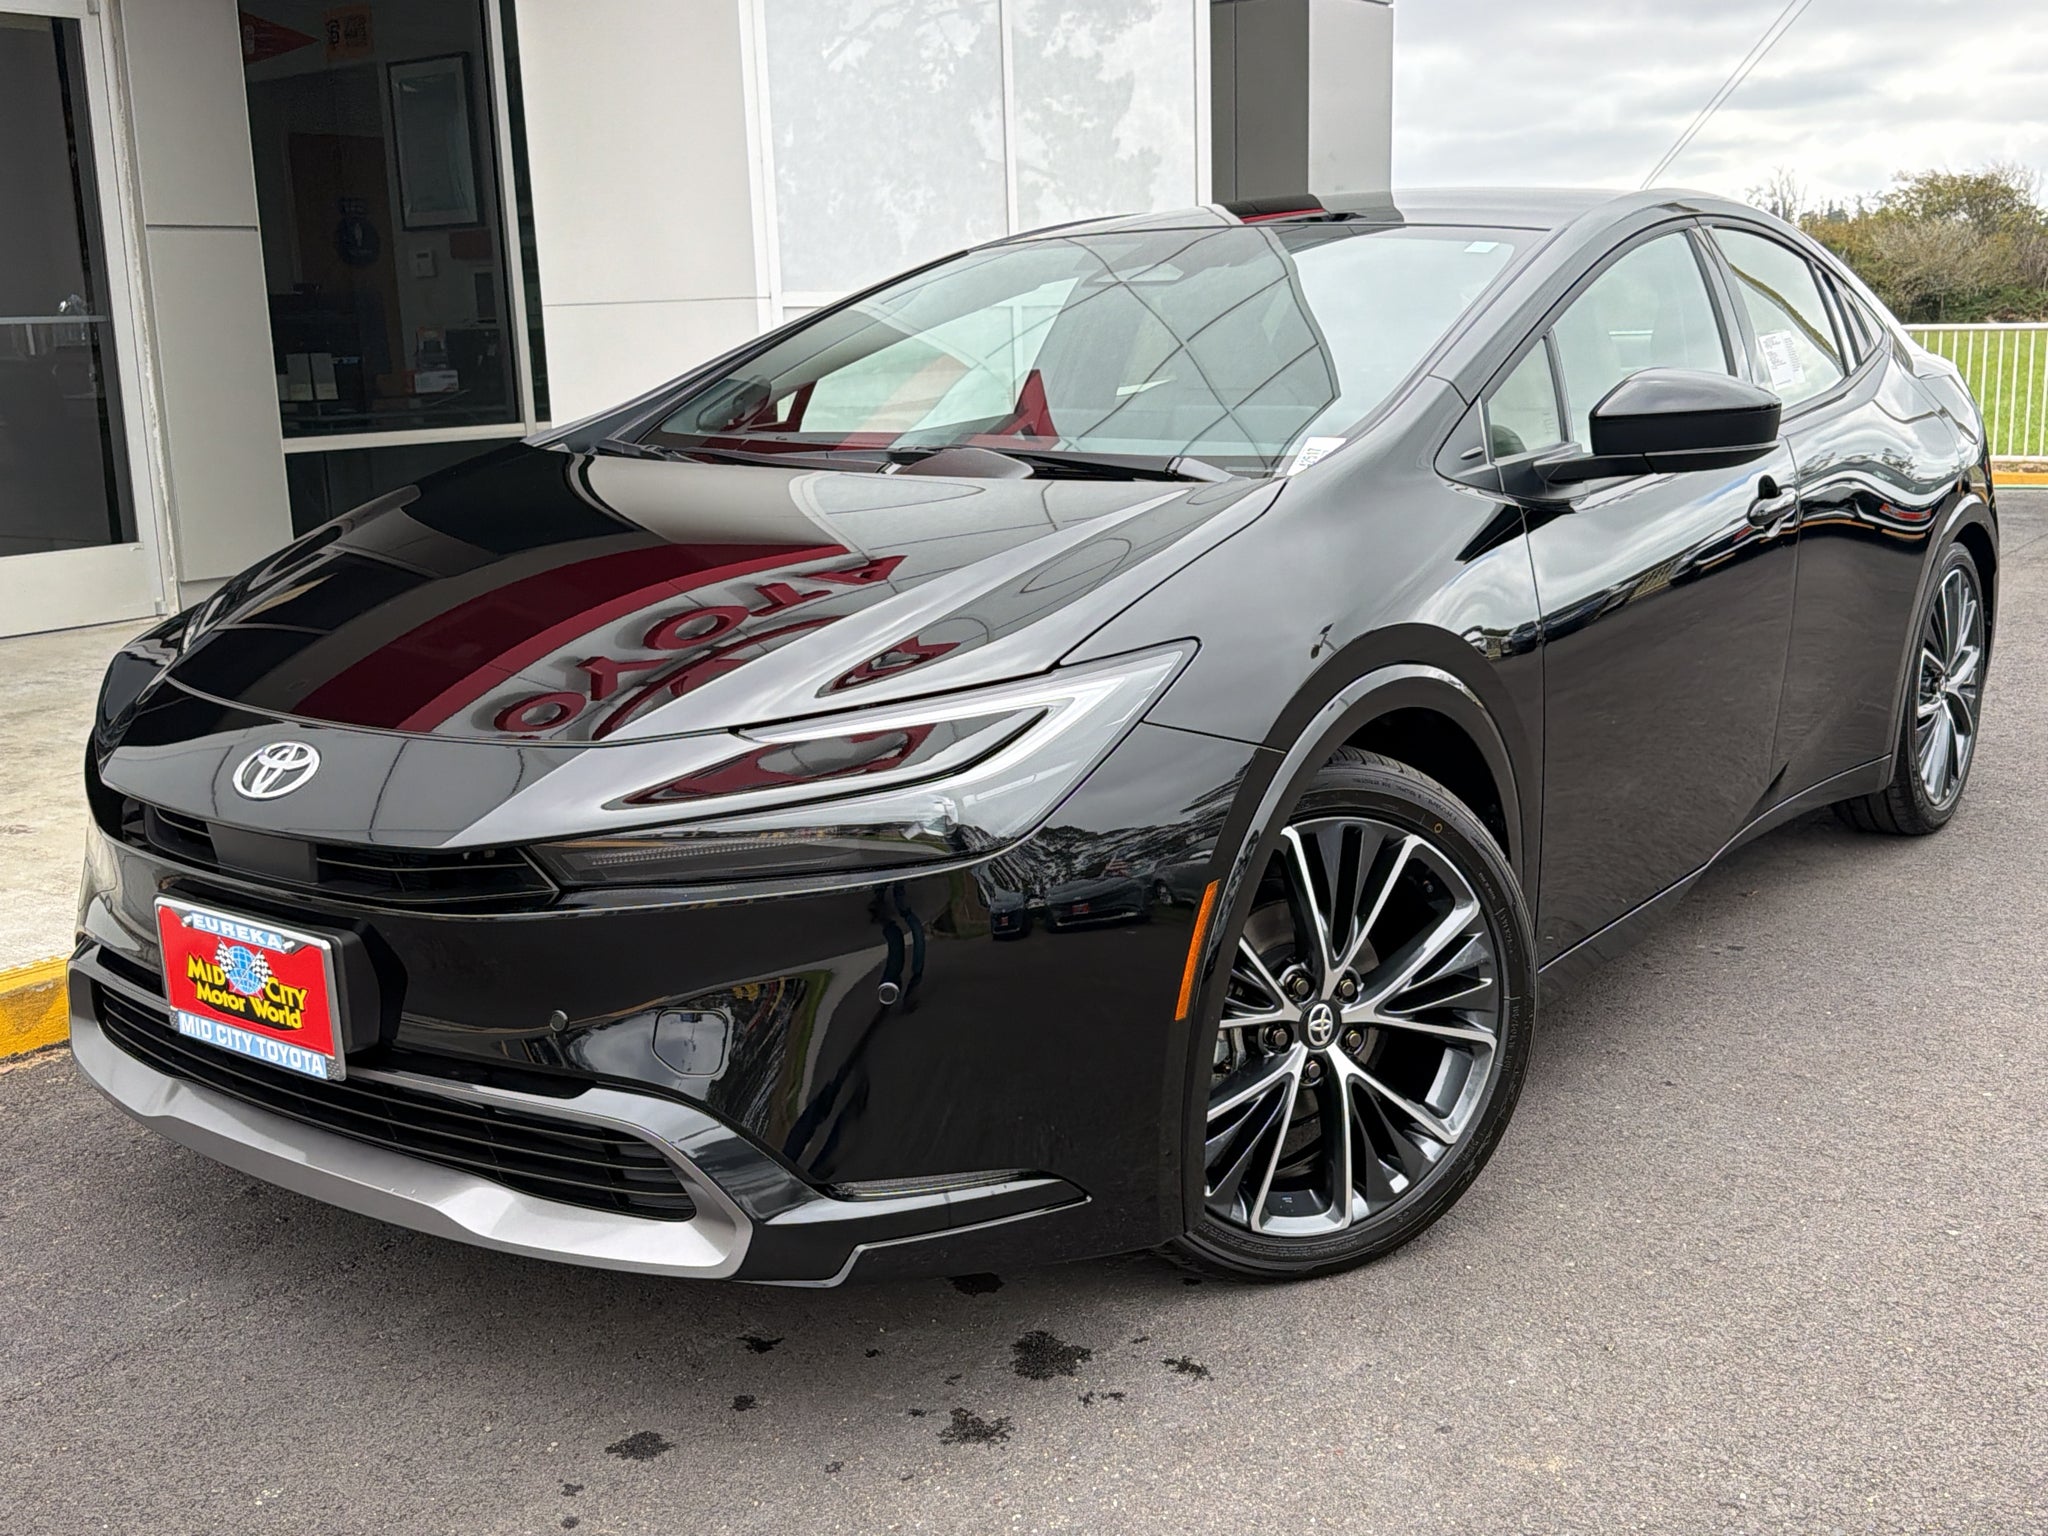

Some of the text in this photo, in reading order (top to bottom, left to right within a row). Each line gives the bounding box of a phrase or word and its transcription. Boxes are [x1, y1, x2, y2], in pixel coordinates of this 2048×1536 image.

[191, 912, 281, 949] EUREKA
[187, 954, 308, 1010] MID CITY
[196, 981, 303, 1029] Motor World
[180, 1014, 325, 1075] MID CITY TOYOTA
